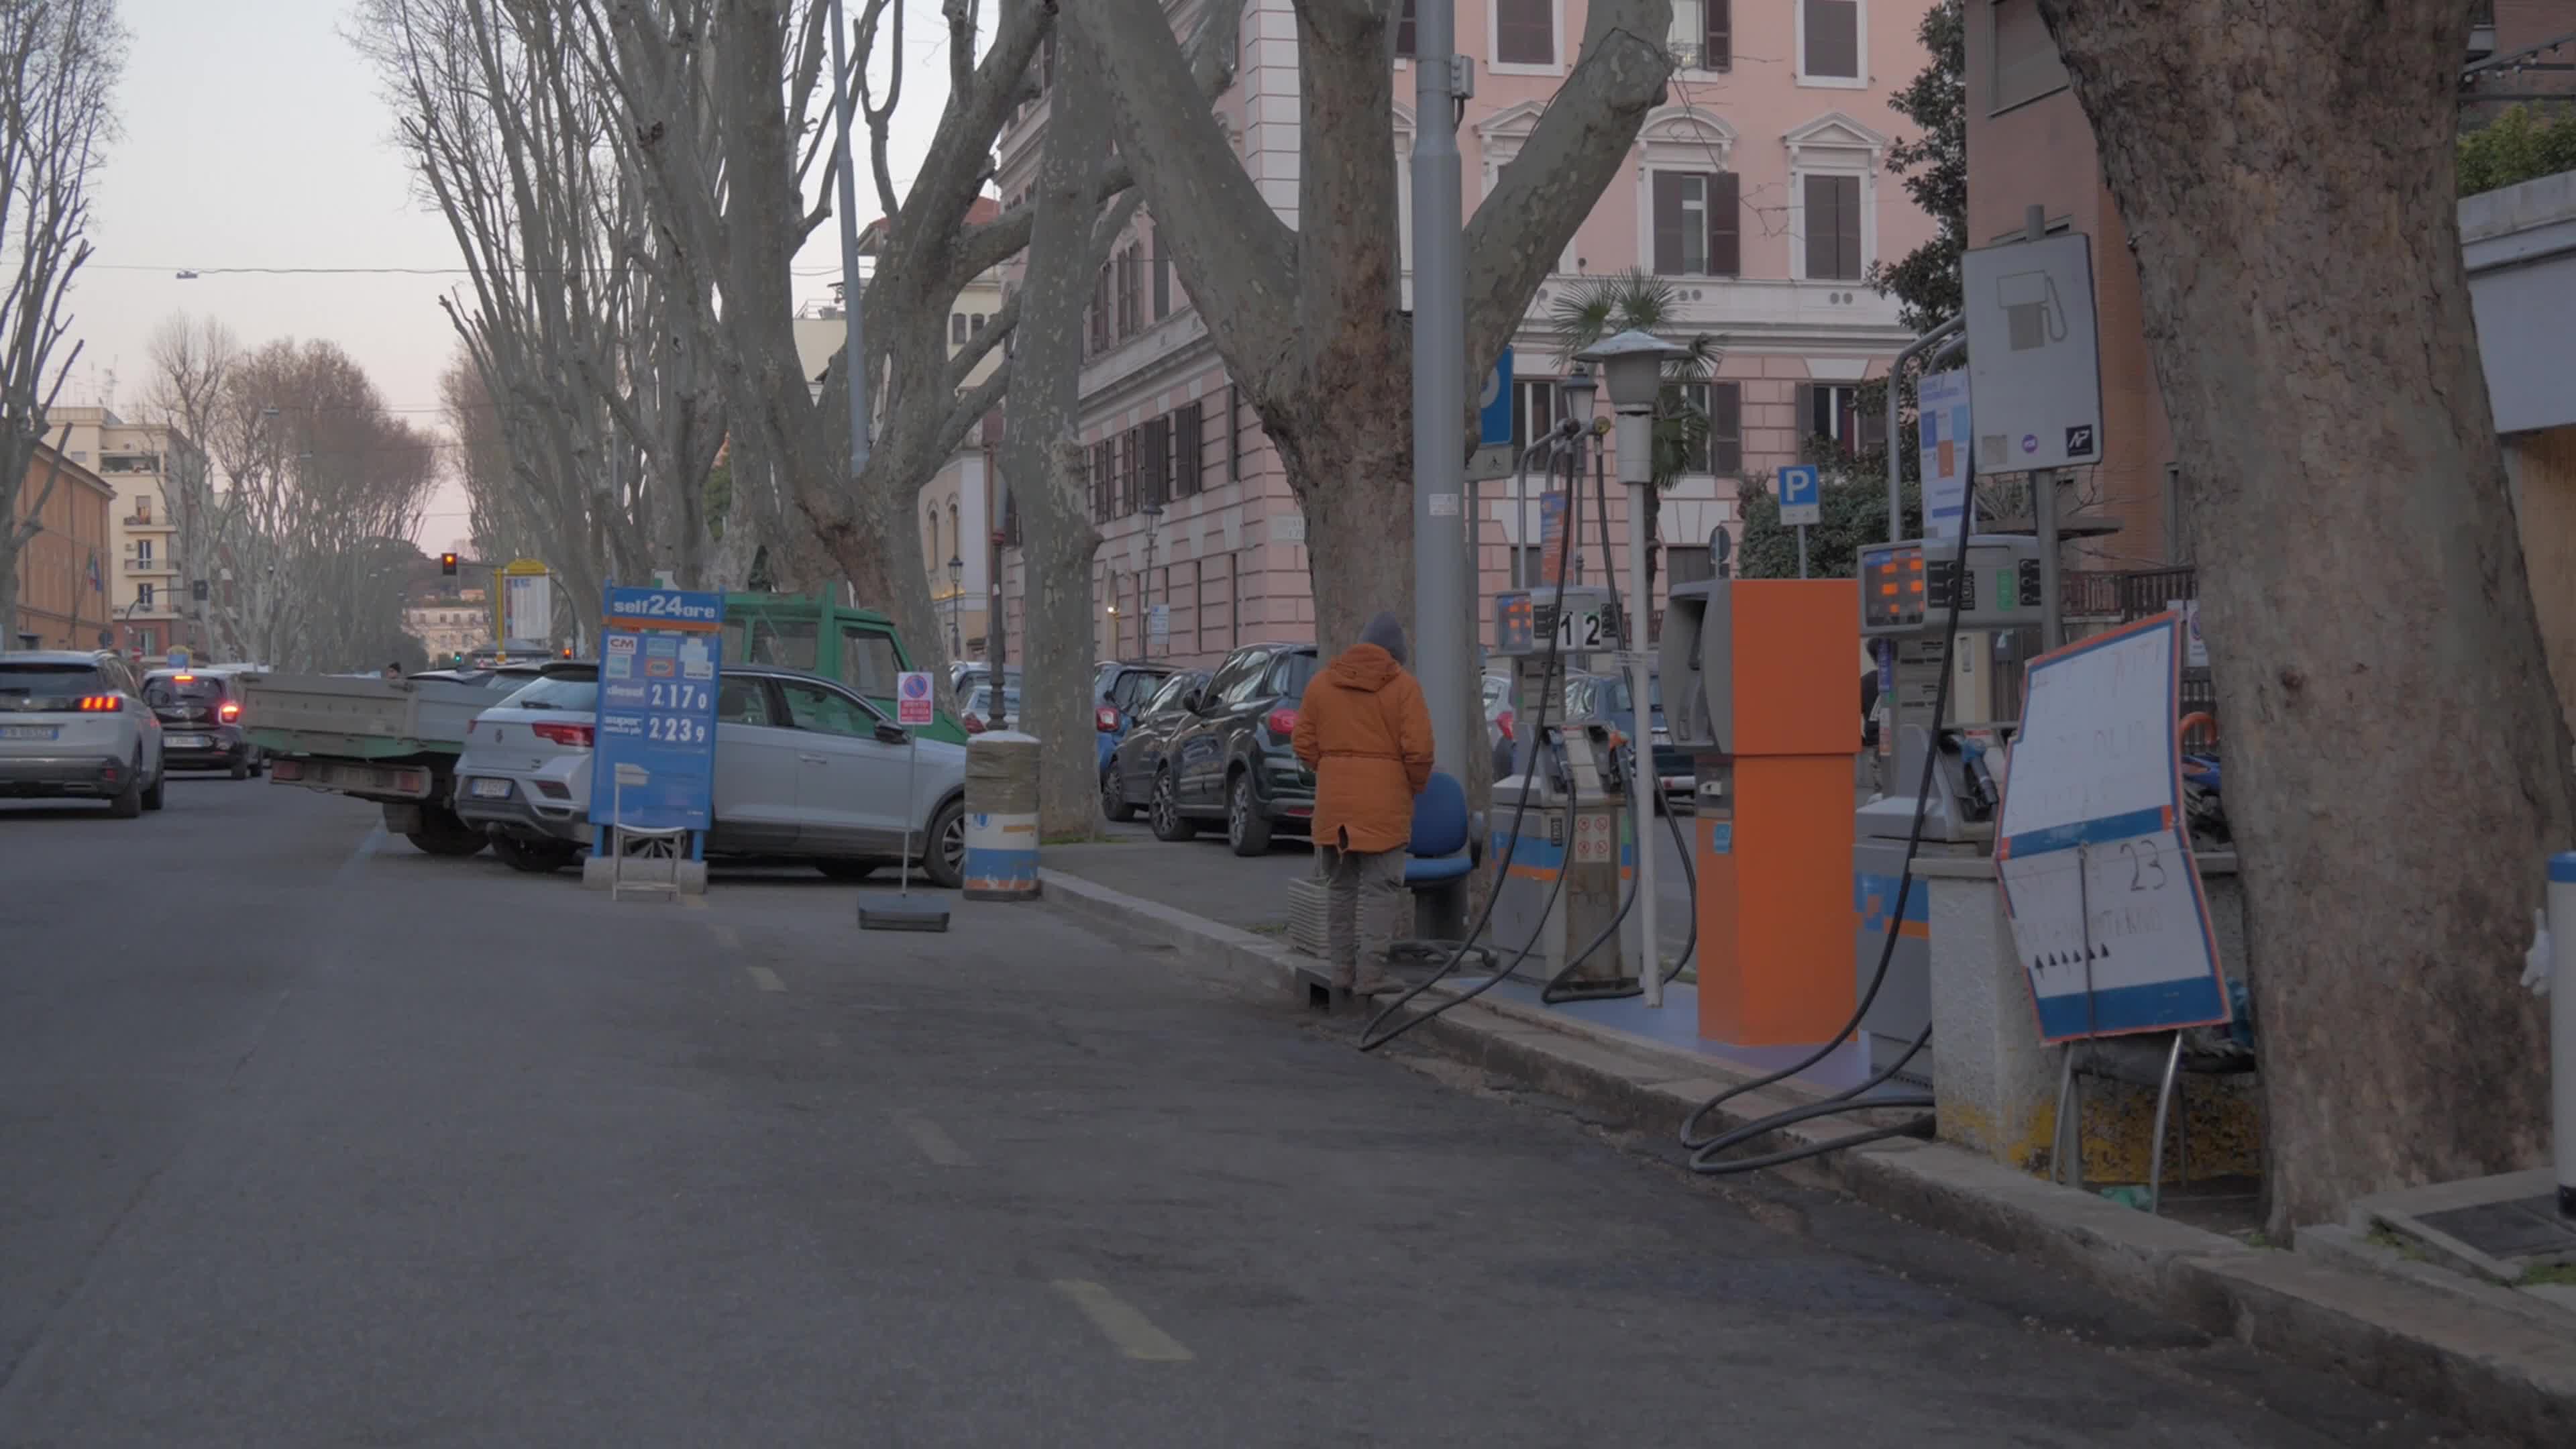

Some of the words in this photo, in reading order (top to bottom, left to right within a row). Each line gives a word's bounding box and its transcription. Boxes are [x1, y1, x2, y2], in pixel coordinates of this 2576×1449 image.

[1786, 470, 1809, 502] P
[613, 594, 715, 618] self24ore
[1586, 614, 1600, 645] 2
[2120, 839, 2167, 891] 23
